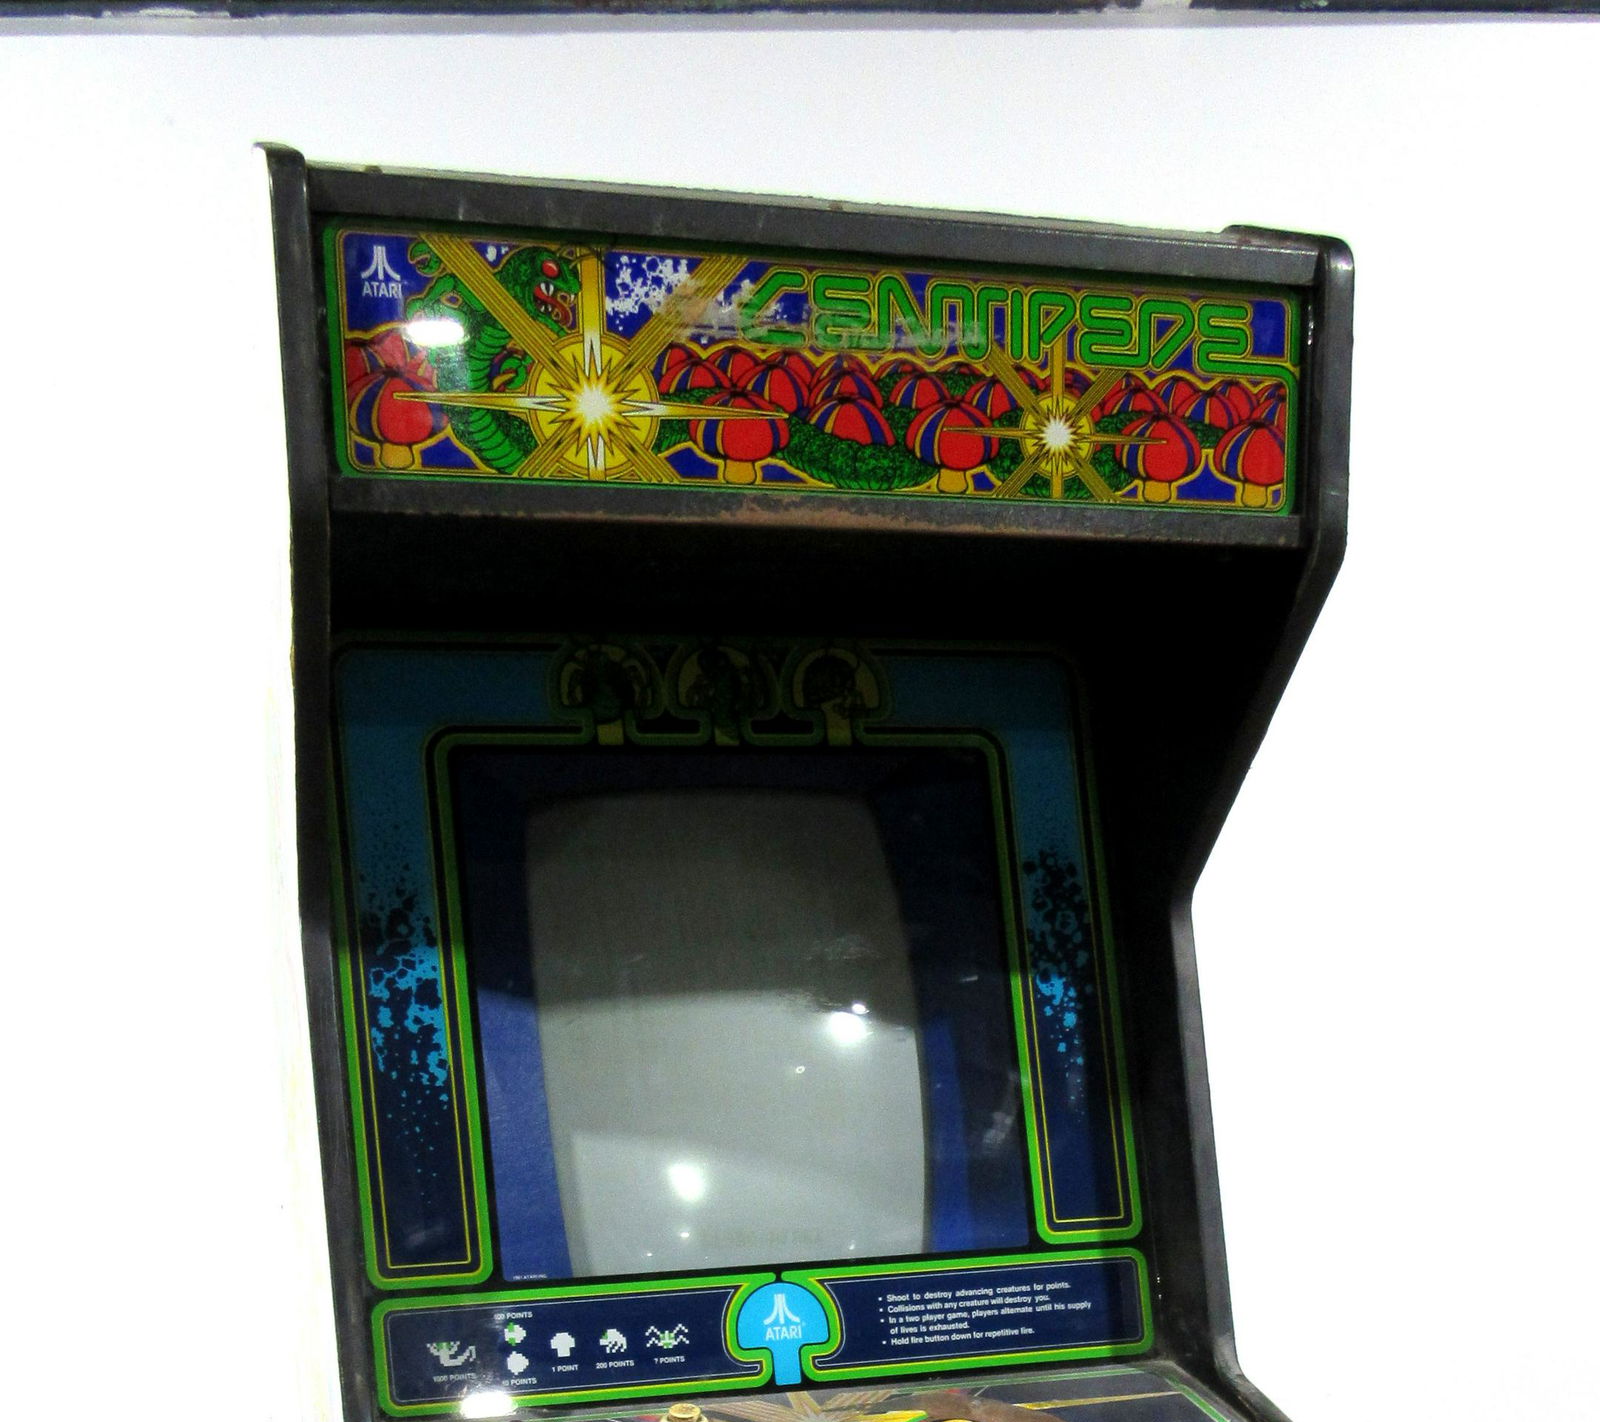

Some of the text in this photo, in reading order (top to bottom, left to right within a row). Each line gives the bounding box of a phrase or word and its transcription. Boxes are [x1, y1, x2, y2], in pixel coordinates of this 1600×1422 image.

[361, 280, 403, 299] ATARI
[740, 269, 1258, 377] CENTIPEDE
[886, 1293, 910, 1302] Shoot
[924, 1291, 952, 1300] destroy
[955, 1287, 993, 1297] advancing
[996, 1285, 1031, 1294] creatures
[1033, 1283, 1044, 1291] for
[887, 1303, 925, 1313] Collisions
[926, 1301, 943, 1310] with
[944, 1301, 958, 1310] any
[959, 1299, 990, 1307] creature
[990, 1297, 1004, 1305] will
[1004, 1295, 1032, 1304] destroy
[506, 1311, 533, 1320] POINTS
[888, 1316, 897, 1324] In
[922, 1312, 945, 1322] player
[971, 1308, 999, 1318] players
[1000, 1306, 1033, 1315] alternate
[1035, 1303, 1053, 1312] until
[1054, 1302, 1066, 1310] his
[1067, 1300, 1092, 1310] supply
[765, 1325, 802, 1341] ATARI
[890, 1326, 899, 1335] of
[900, 1325, 918, 1334] lives
[928, 1321, 970, 1332] exhausted.
[890, 1326, 1035, 1346] Hold fire button down for repetitive fire.
[608, 1360, 635, 1368] POINTS
[659, 1355, 686, 1364] POINTS
[557, 1364, 579, 1372] POINT
[449, 1372, 477, 1381] POINTS
[510, 1377, 538, 1386] POINTS
